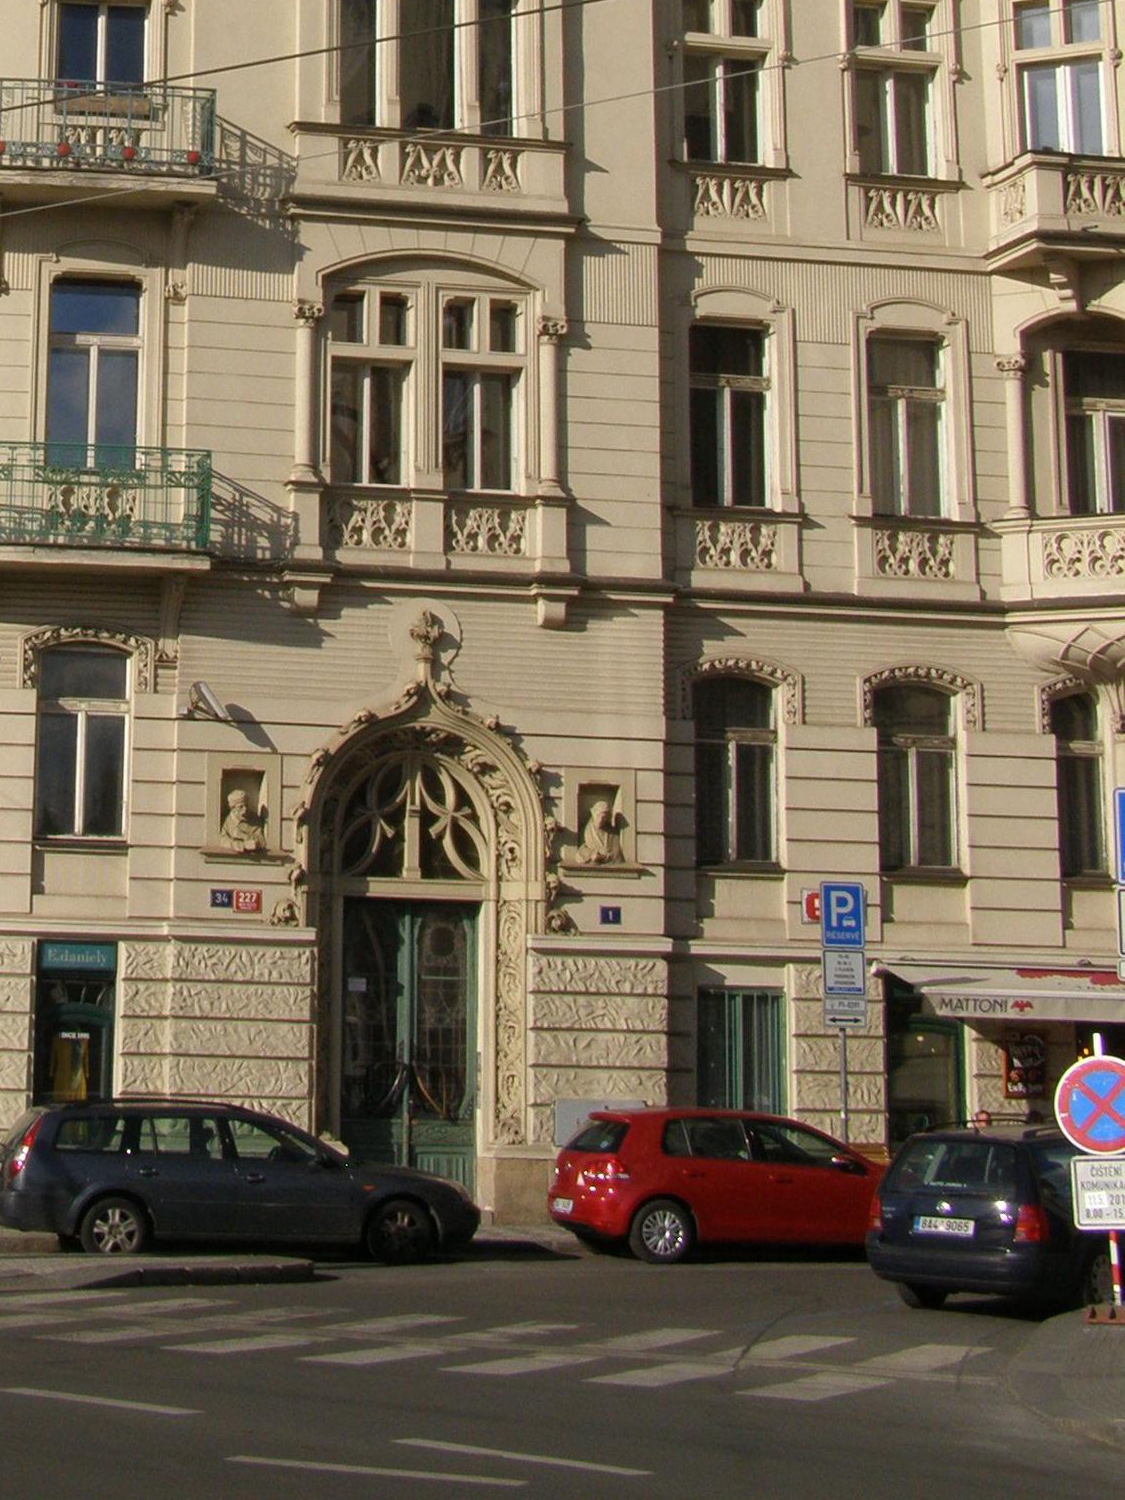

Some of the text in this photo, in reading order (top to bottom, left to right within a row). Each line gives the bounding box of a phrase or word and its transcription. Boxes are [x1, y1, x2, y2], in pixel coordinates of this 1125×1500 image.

[215, 892, 229, 903] 34
[238, 892, 257, 902] 227
[830, 890, 854, 927] P
[608, 910, 613, 920] 1
[939, 998, 1008, 1013] MATTONI
